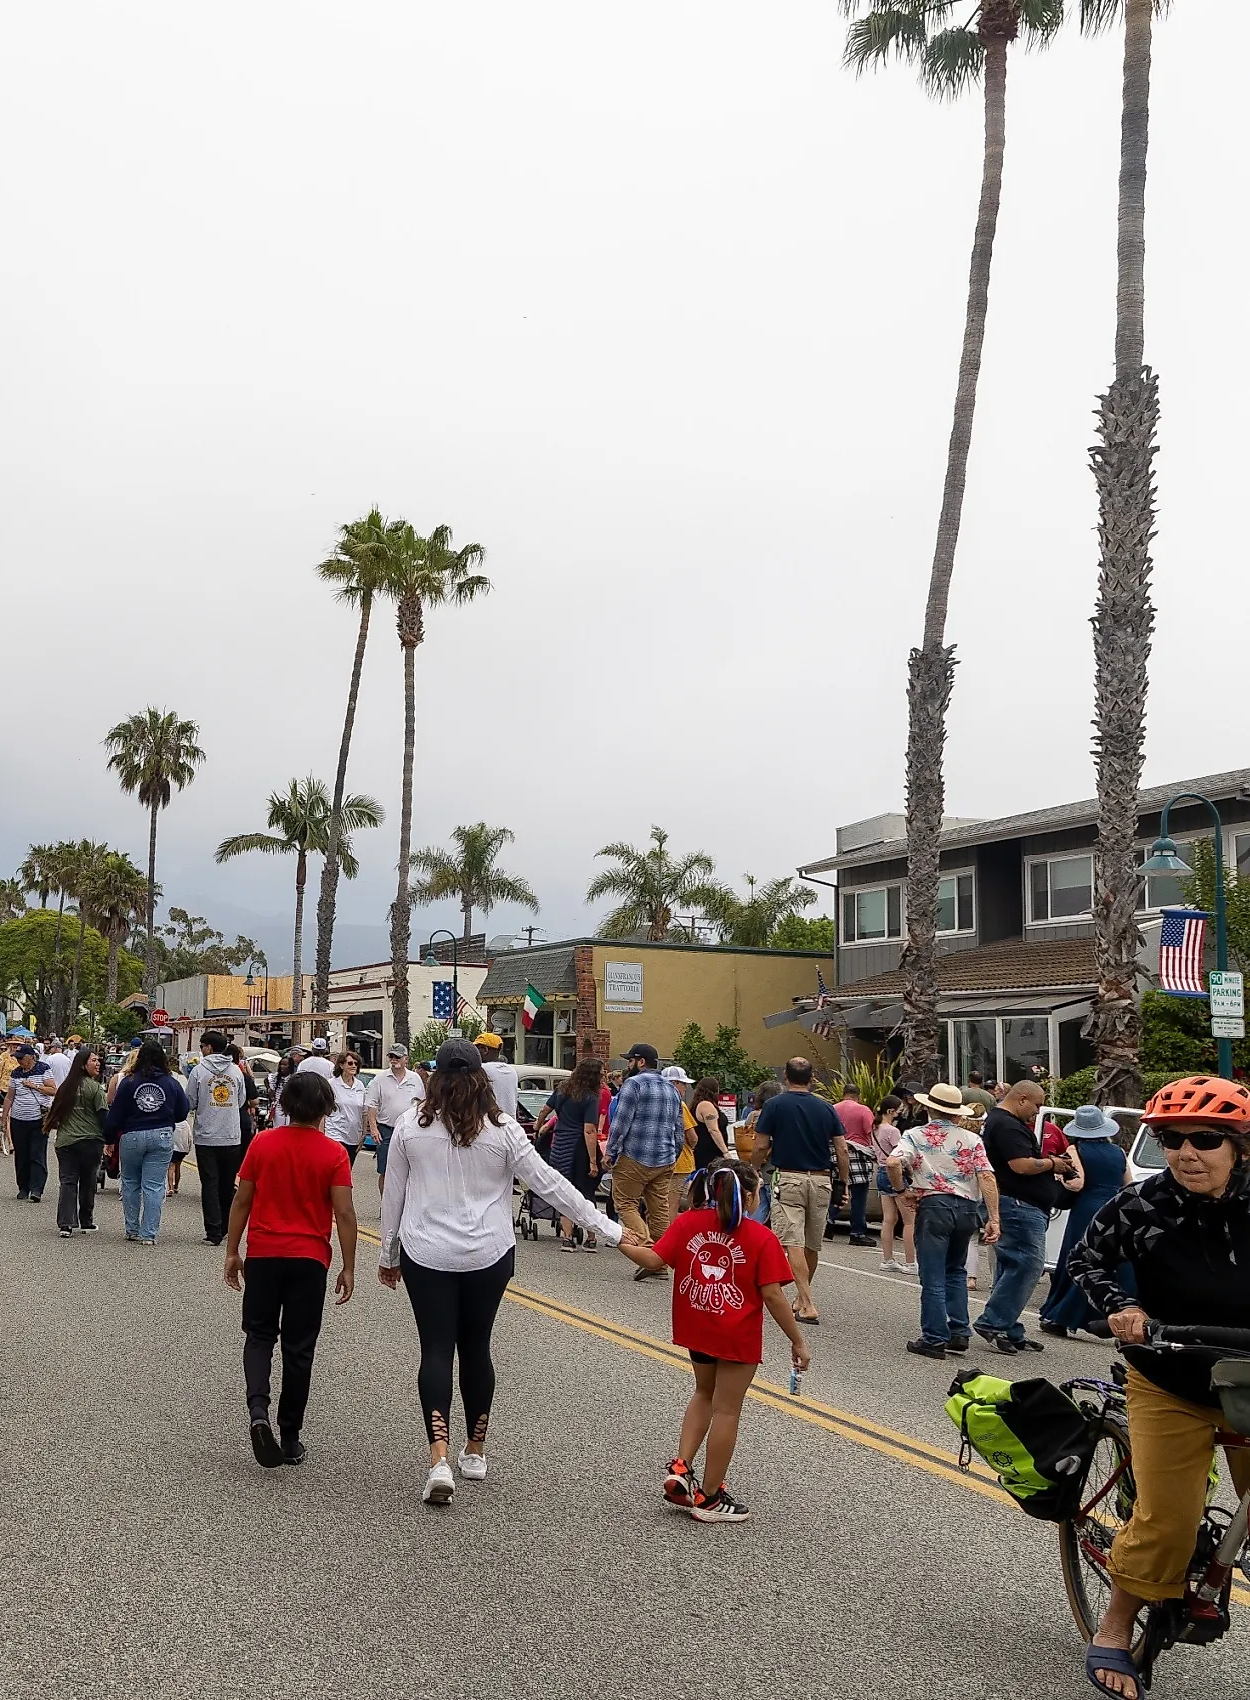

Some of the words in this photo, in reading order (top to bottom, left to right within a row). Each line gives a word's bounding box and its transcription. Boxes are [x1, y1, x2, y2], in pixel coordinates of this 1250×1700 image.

[1212, 974, 1222, 984] 90
[1224, 976, 1240, 984] MINUTE
[609, 984, 640, 992] TRATTORIA
[1213, 988, 1242, 997] PARKING
[153, 1014, 168, 1022] STOP
[707, 1230, 730, 1245] SMART
[730, 1245, 747, 1264] BOLD
